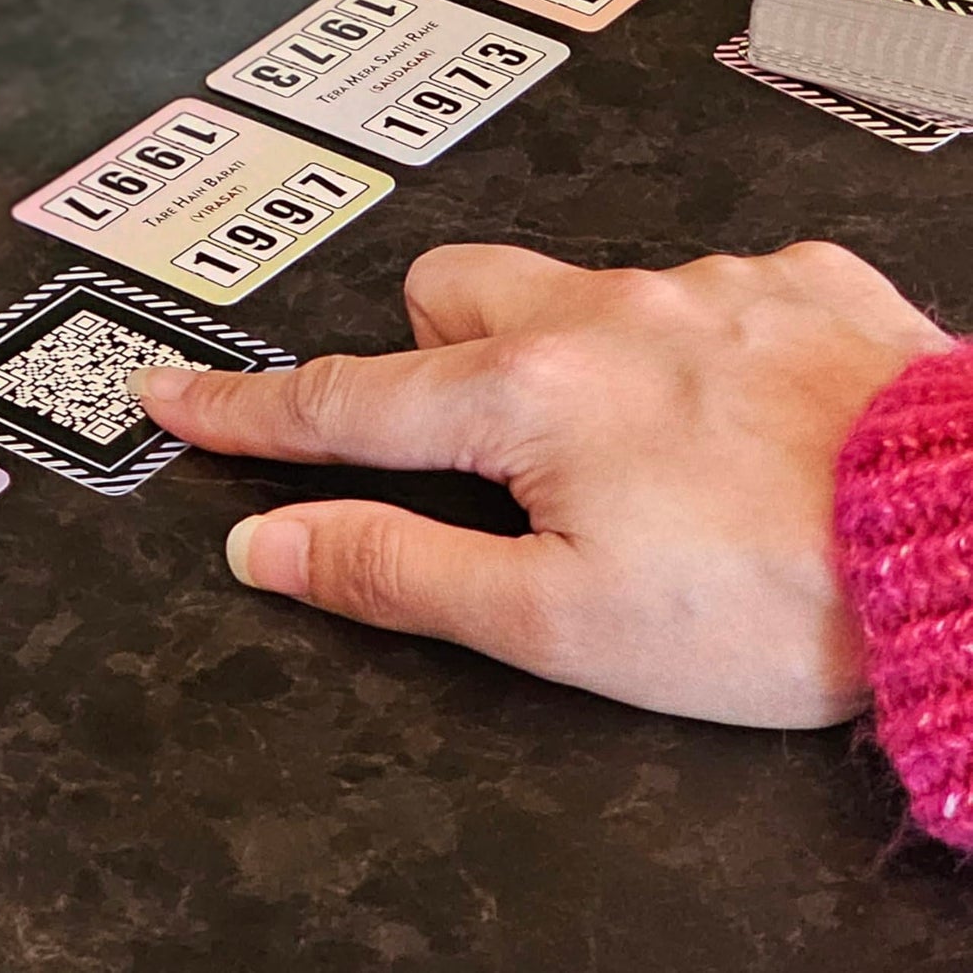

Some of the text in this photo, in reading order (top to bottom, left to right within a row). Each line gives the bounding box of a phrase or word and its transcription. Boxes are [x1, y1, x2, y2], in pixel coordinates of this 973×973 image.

[315, 20, 439, 105] TERA MERA SAATH RAHE
[368, 48, 436, 94] (SAUDAGAR)
[382, 42, 529, 138] 1973
[63, 123, 218, 222] 1997
[141, 159, 246, 228] TARE HAIN BARATI
[189, 184, 249, 223] (VIRASAT)
[192, 171, 349, 275] 1997
